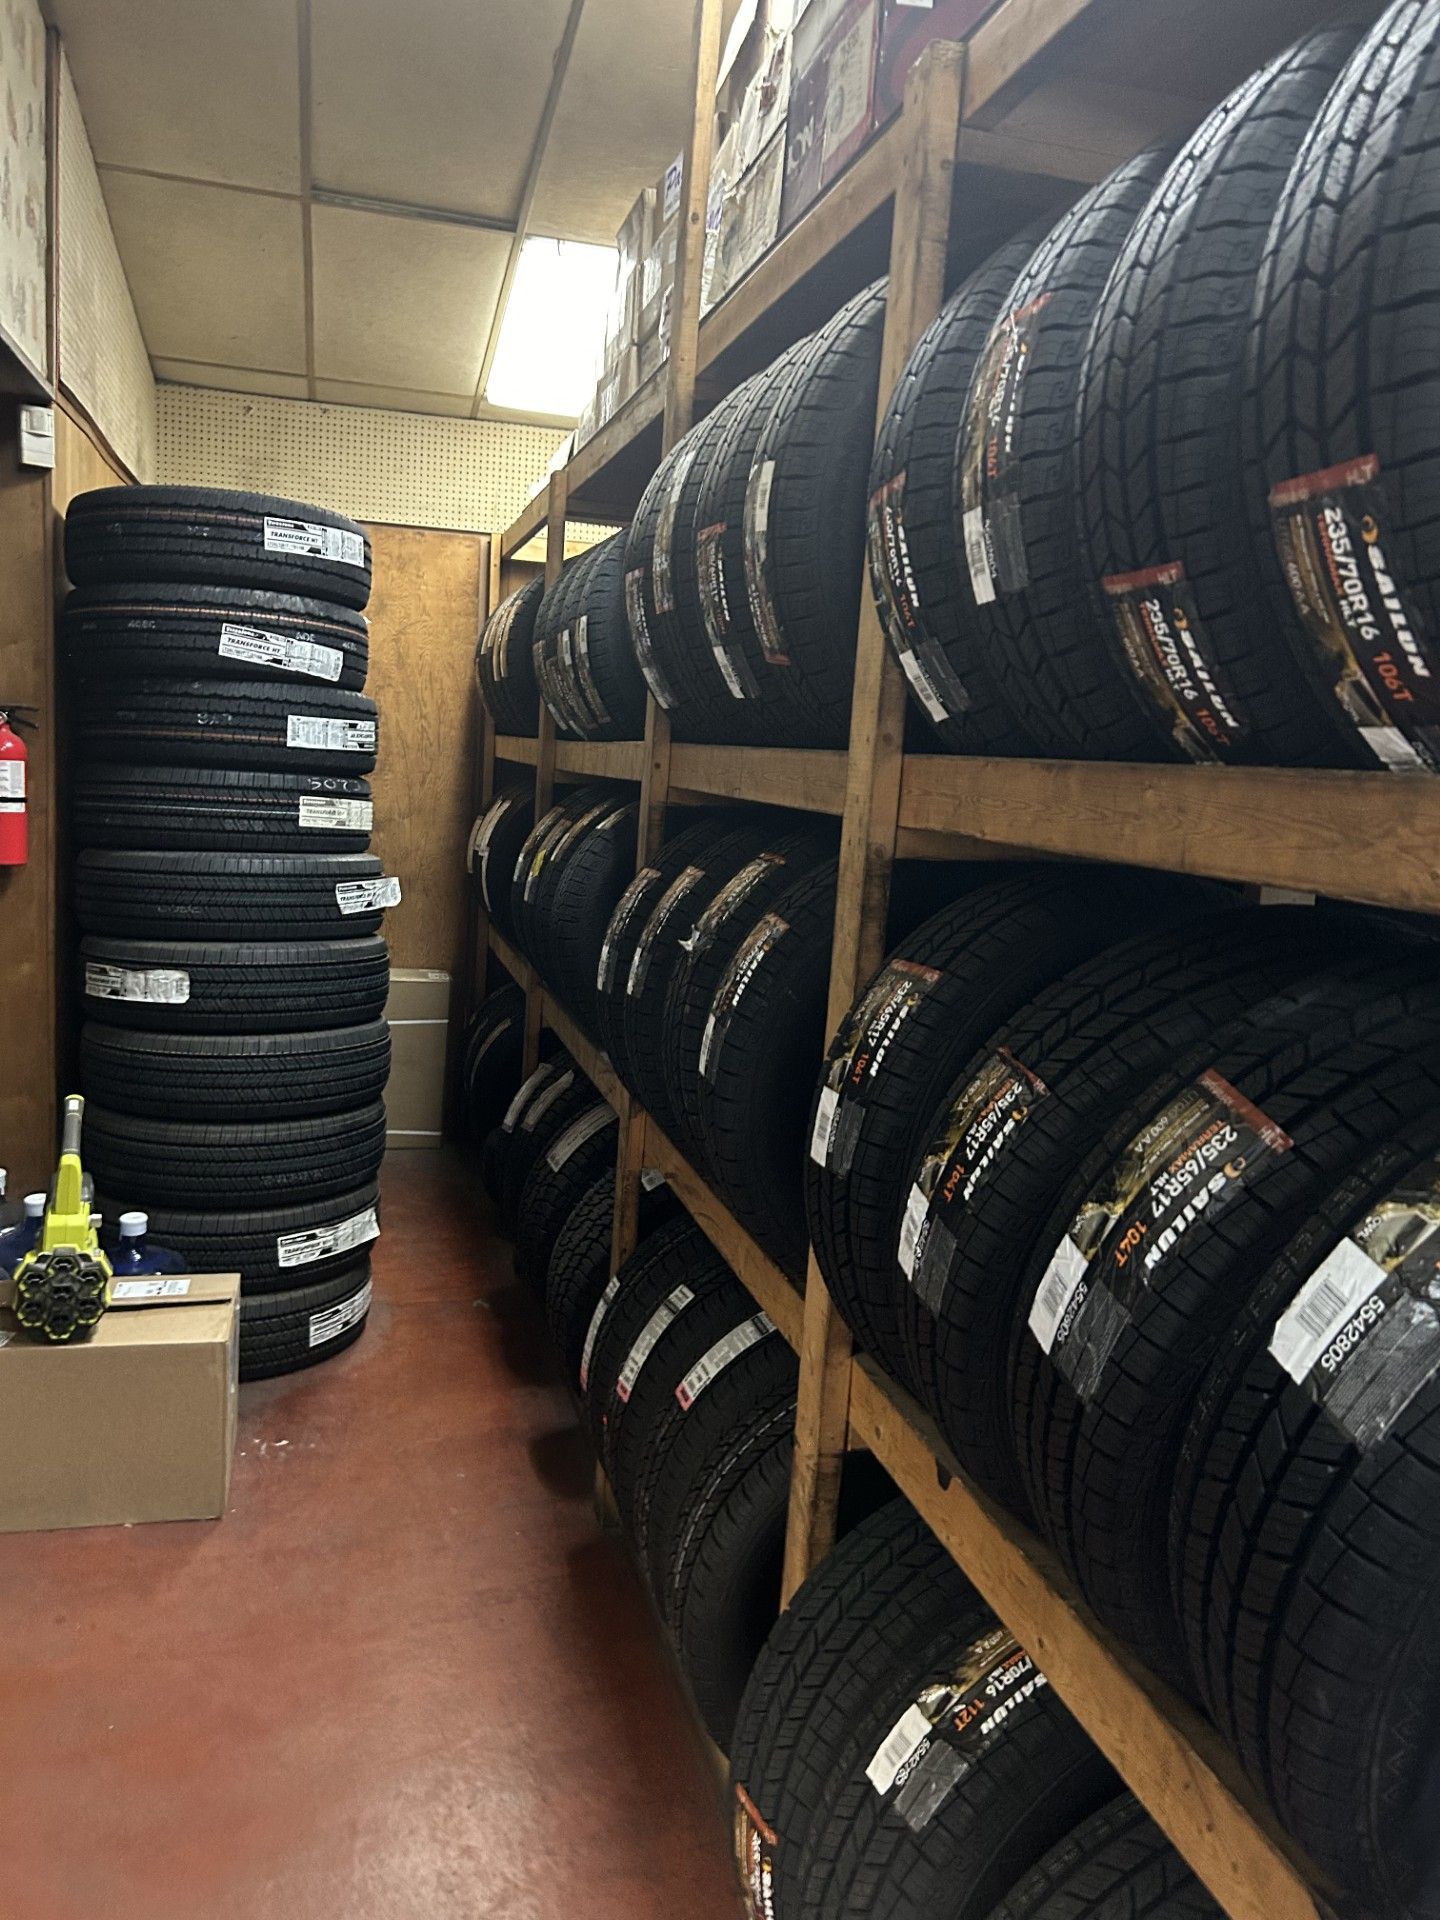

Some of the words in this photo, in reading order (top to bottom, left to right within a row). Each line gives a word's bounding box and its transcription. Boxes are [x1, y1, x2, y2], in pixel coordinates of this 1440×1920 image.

[271, 531, 309, 542] TRANSFORCE
[1323, 505, 1381, 638] 235/70R16
[1372, 650, 1412, 701] 106T
[1369, 544, 1431, 675] SAILUN
[227, 637, 270, 652] TRANSFORCE
[1145, 598, 1198, 699] 235/70R16
[1179, 630, 1239, 727] SAILUN
[867, 980, 912, 1047] 235/65R17
[869, 1003, 909, 1077] SAILUN
[964, 1080, 1022, 1160] 235/65R17
[1132, 1142, 1142, 1151] A
[1141, 1132, 1150, 1142] A
[1148, 1115, 1169, 1137] 600
[1167, 1119, 1225, 1175] TERRAMAX
[961, 1117, 1015, 1201] SAILUN
[1149, 1124, 1238, 1219] 235/65R17
[1149, 1170, 1169, 1196] HLT
[1112, 1219, 1148, 1268] 104T
[1142, 1171, 1227, 1270] SAILUN
[1319, 1294, 1386, 1372] 5542805
[952, 1696, 985, 1732] 112T
[979, 1672, 1047, 1735] SAILUN
